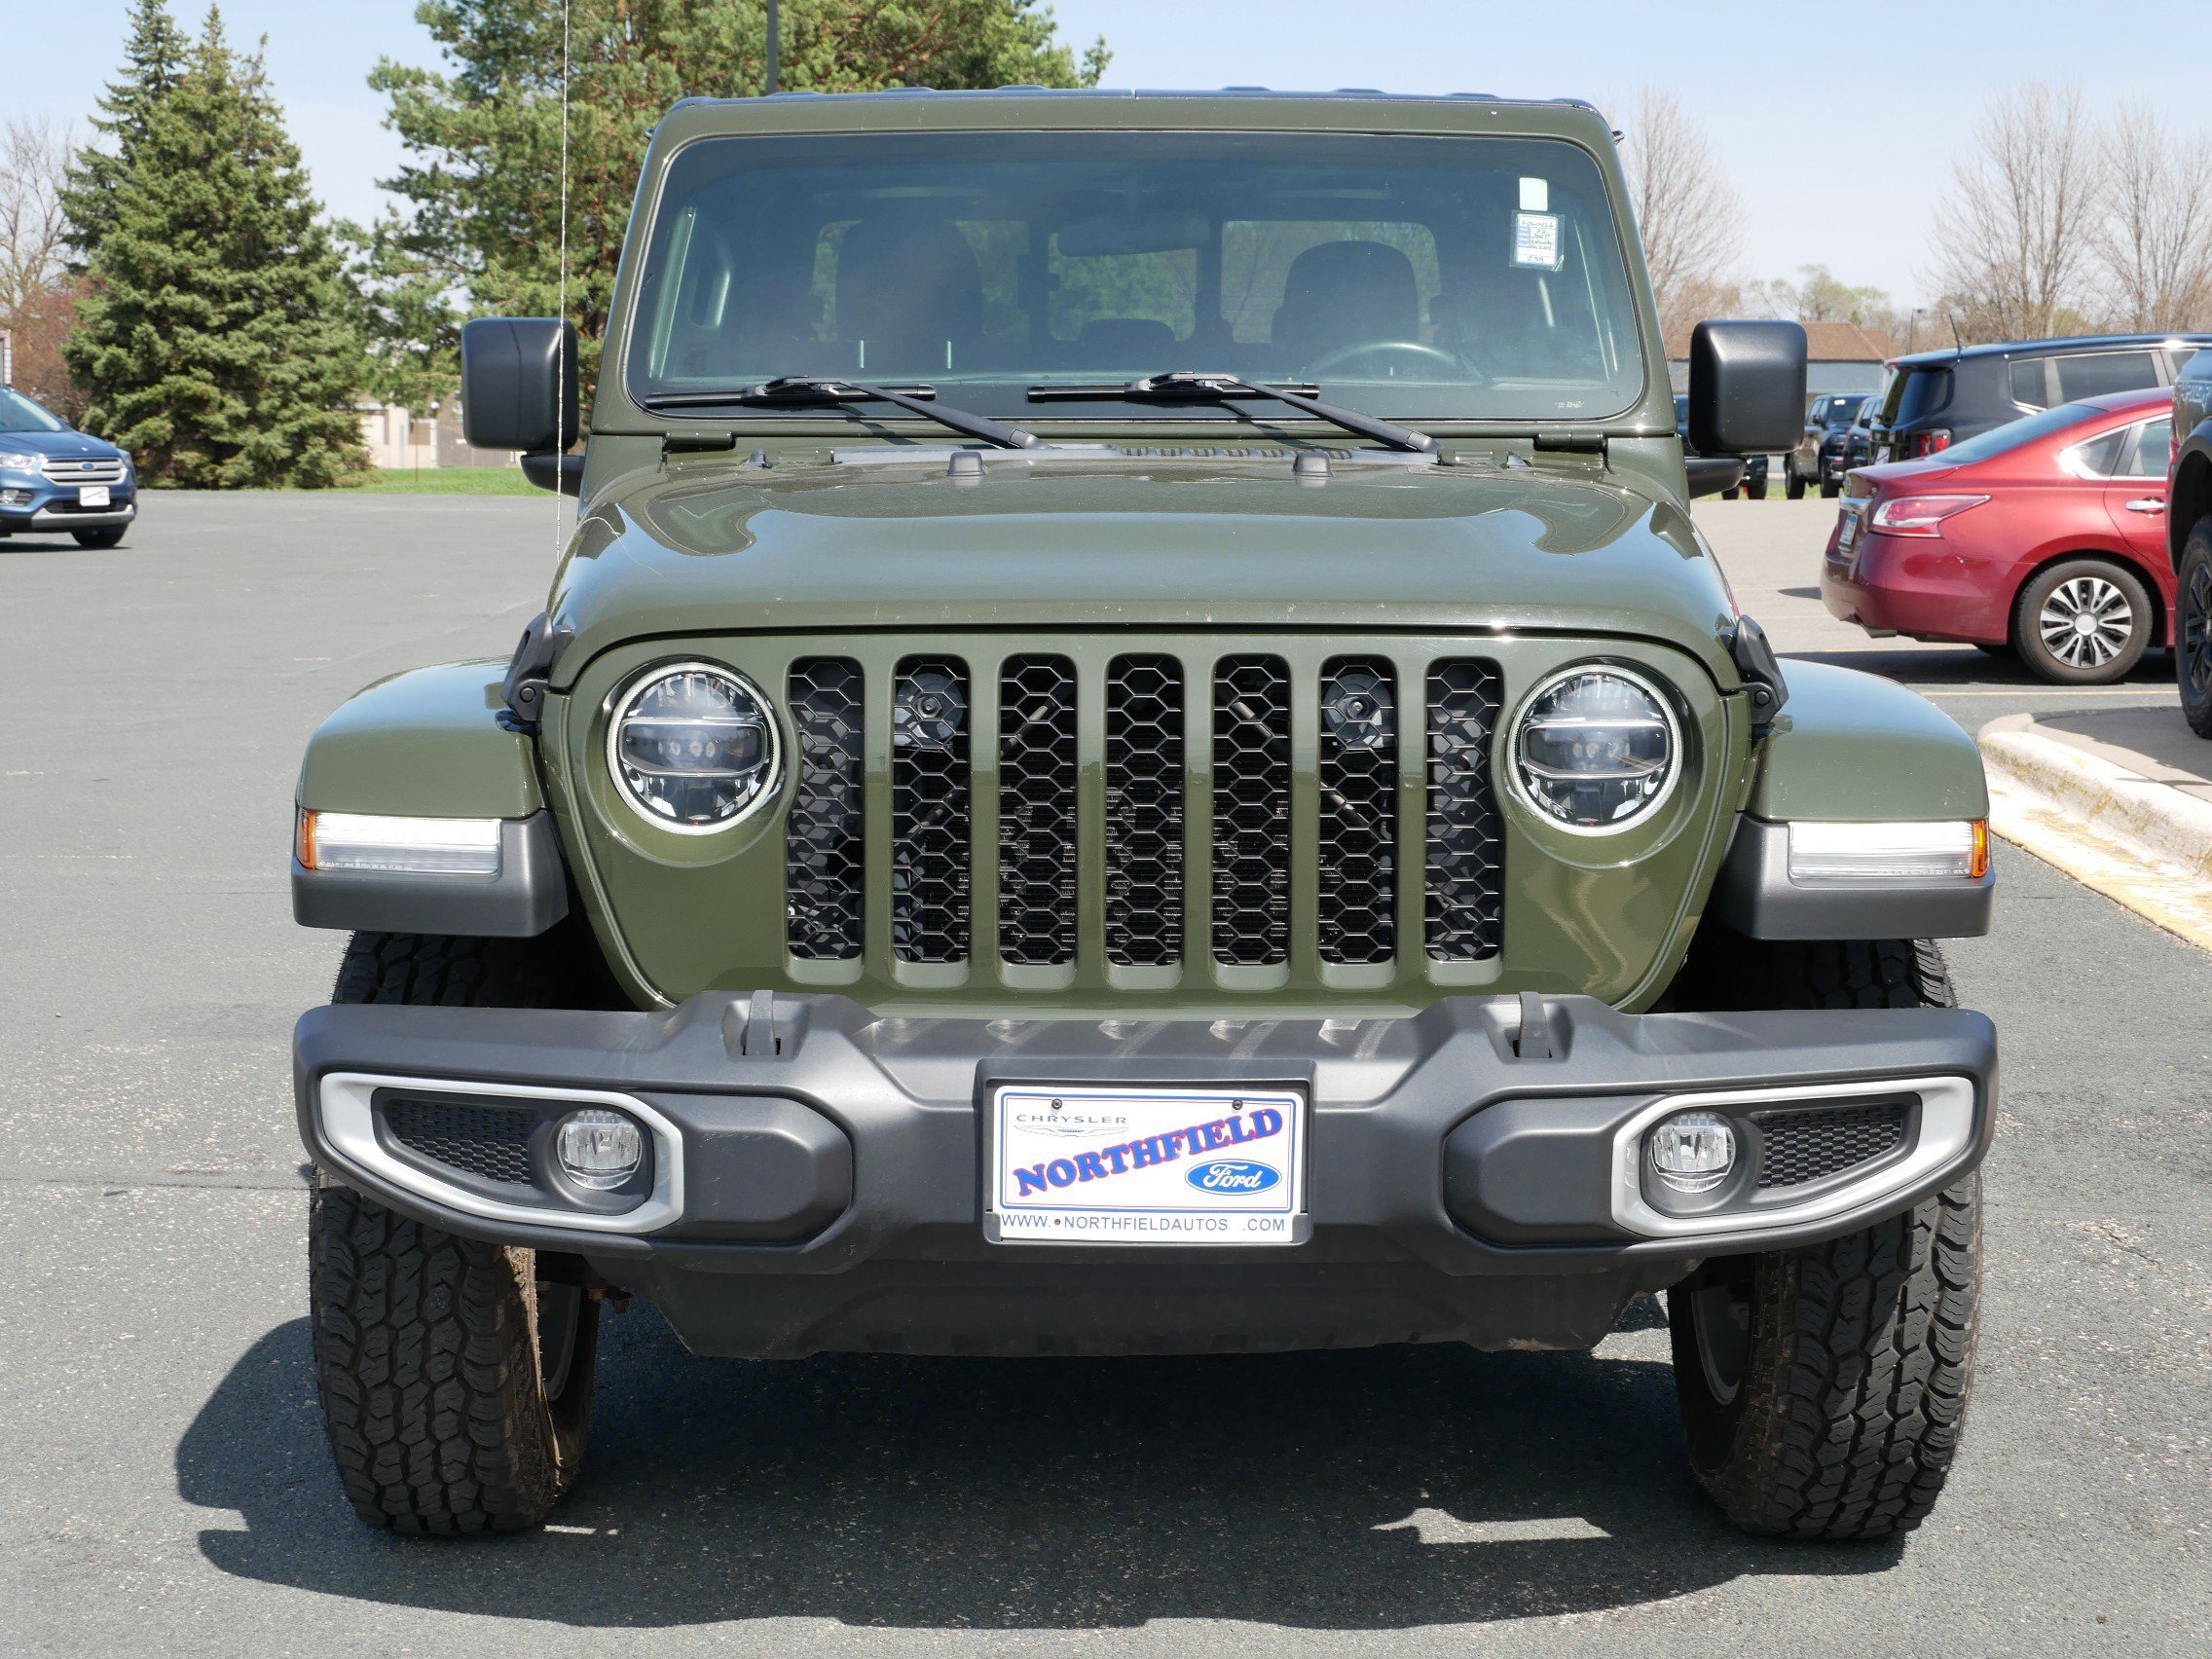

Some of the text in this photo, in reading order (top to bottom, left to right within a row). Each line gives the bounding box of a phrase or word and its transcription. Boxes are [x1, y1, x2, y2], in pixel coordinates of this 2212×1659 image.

[1015, 1114, 1126, 1124] CHRYSLER
[1014, 1108, 1282, 1197] NORTHFIELD
[1202, 1162, 1262, 1188] Ford
[1064, 1216, 1228, 1232] NORTHFIELDAUTOS
